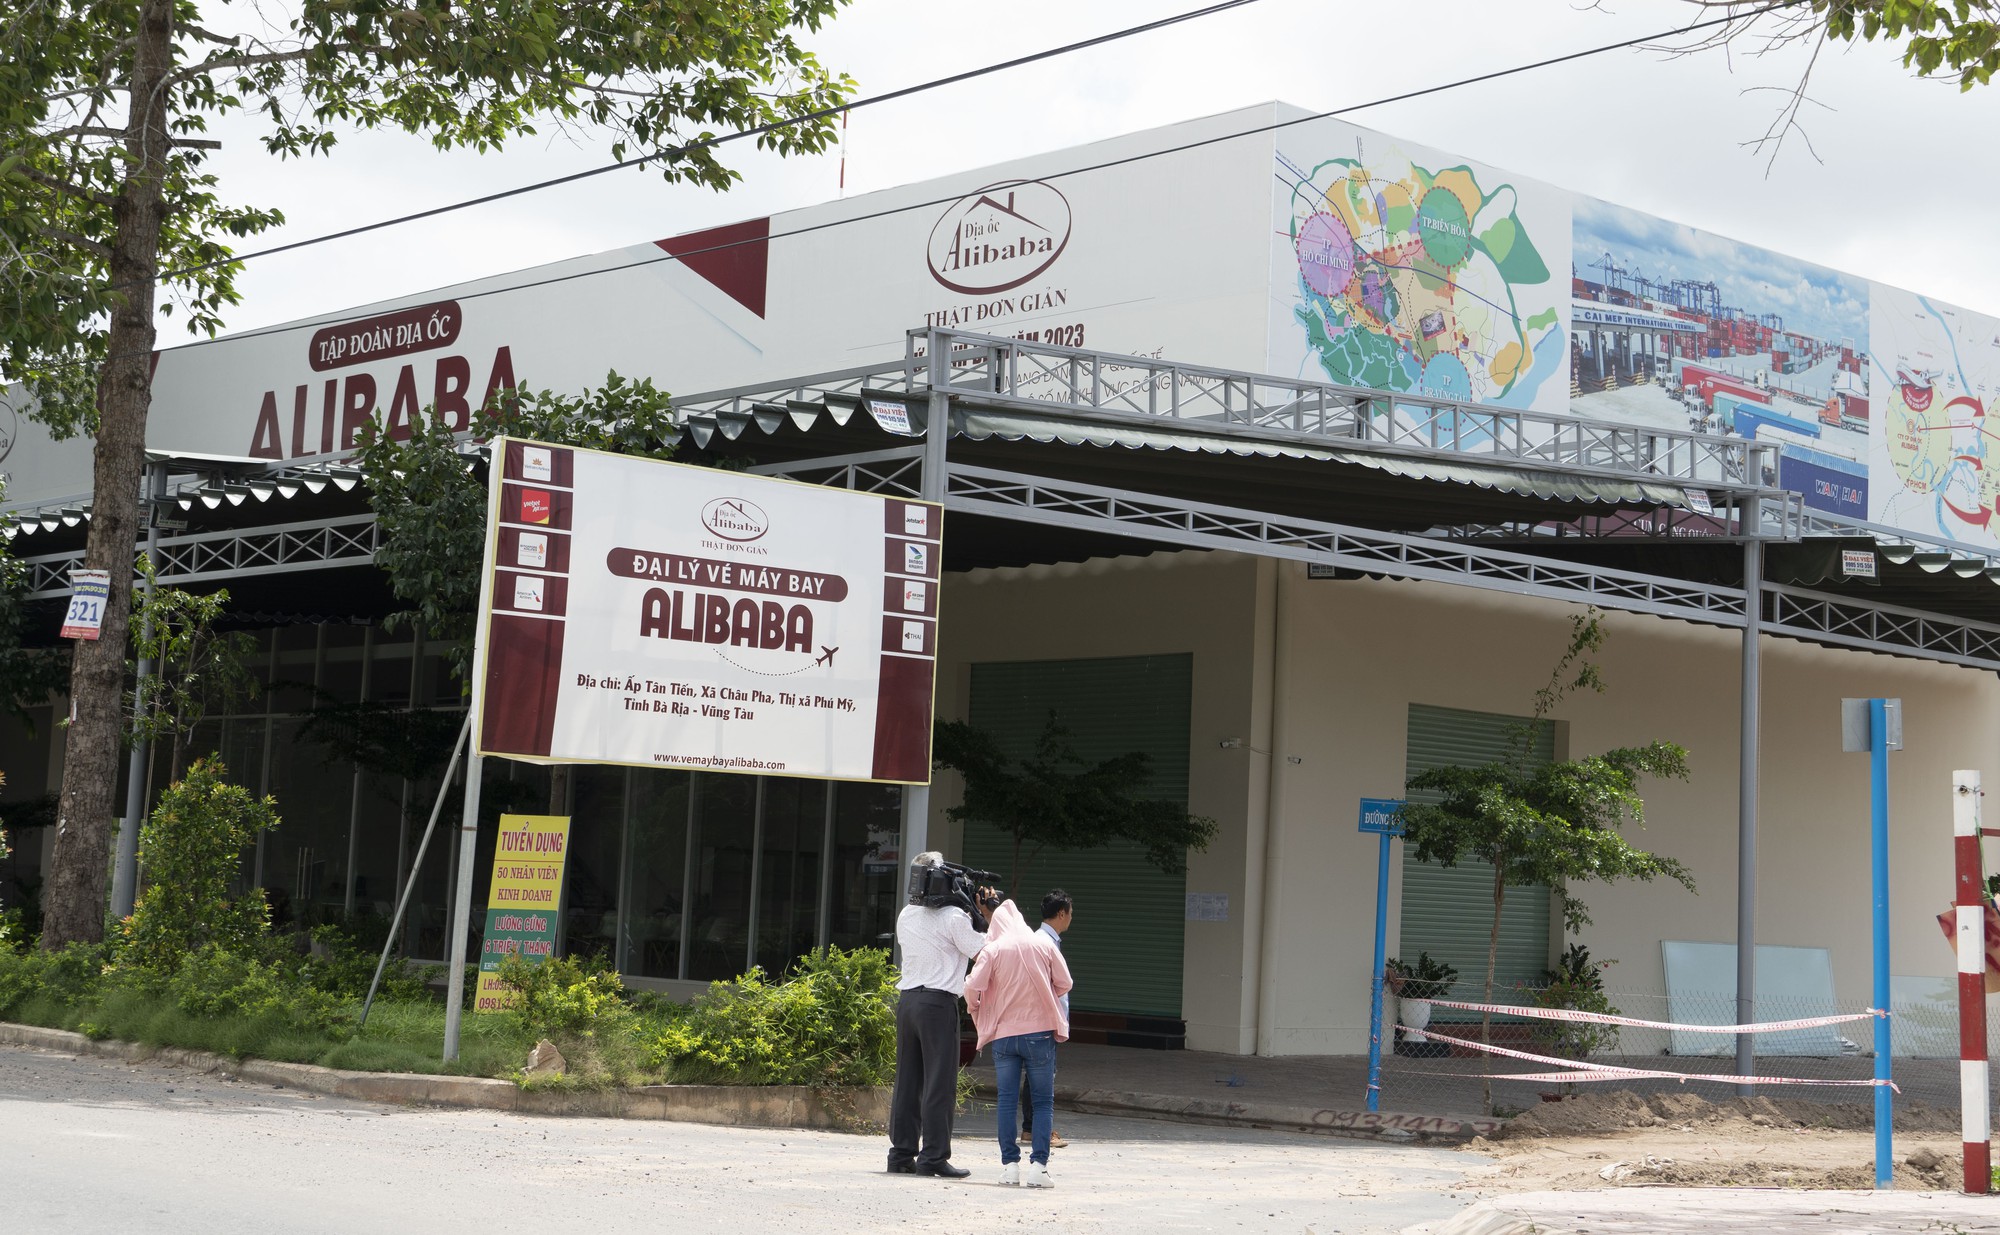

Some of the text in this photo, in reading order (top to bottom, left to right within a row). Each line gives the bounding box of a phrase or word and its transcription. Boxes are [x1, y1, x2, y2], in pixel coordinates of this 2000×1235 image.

[965, 214, 1000, 240] Địa ốc
[941, 219, 1053, 272] Alibaba
[1322, 238, 1331, 249] TP
[1315, 252, 1328, 265] CHÍ
[1330, 256, 1349, 270] MINH
[924, 286, 1067, 329] THẬT ĐƠN GIẢN
[1584, 311, 1696, 331] CAI MEP INTERNATIONAL TERMINAL
[319, 309, 451, 364] TẬP ĐOÀN ĐỊA ỐC
[1044, 323, 1084, 347] 2023
[1151, 346, 1164, 360] TẾ
[1442, 375, 1452, 386] TP
[1816, 479, 1863, 505] WAN HAI
[709, 507, 761, 533] Alibaba
[701, 540, 768, 555] THẬT ĐƠN GIẢN
[633, 555, 825, 595] ĐẠI LÝ VÉ MÁY BAY
[68, 601, 98, 622] 321
[640, 587, 814, 654] ALIBABA
[577, 674, 857, 713] Địa chỉ: Ấp Tân Tiến, Xã Châu Pha, Thị xã Phú Mỹ,
[624, 697, 649, 711] Tỉnh
[653, 699, 667, 713] Bà
[671, 704, 689, 716] Rịa
[701, 705, 730, 721] Vũng
[734, 707, 754, 720] Tàu
[653, 753, 786, 770] www.vemaybayalibaba.com
[502, 821, 564, 856] TUYỂN DỤNG
[497, 865, 558, 880] 50 NHÂN VIÊN
[497, 889, 552, 901] KINH DOANH
[485, 939, 491, 953] 6
[523, 937, 552, 955] THÁNG
